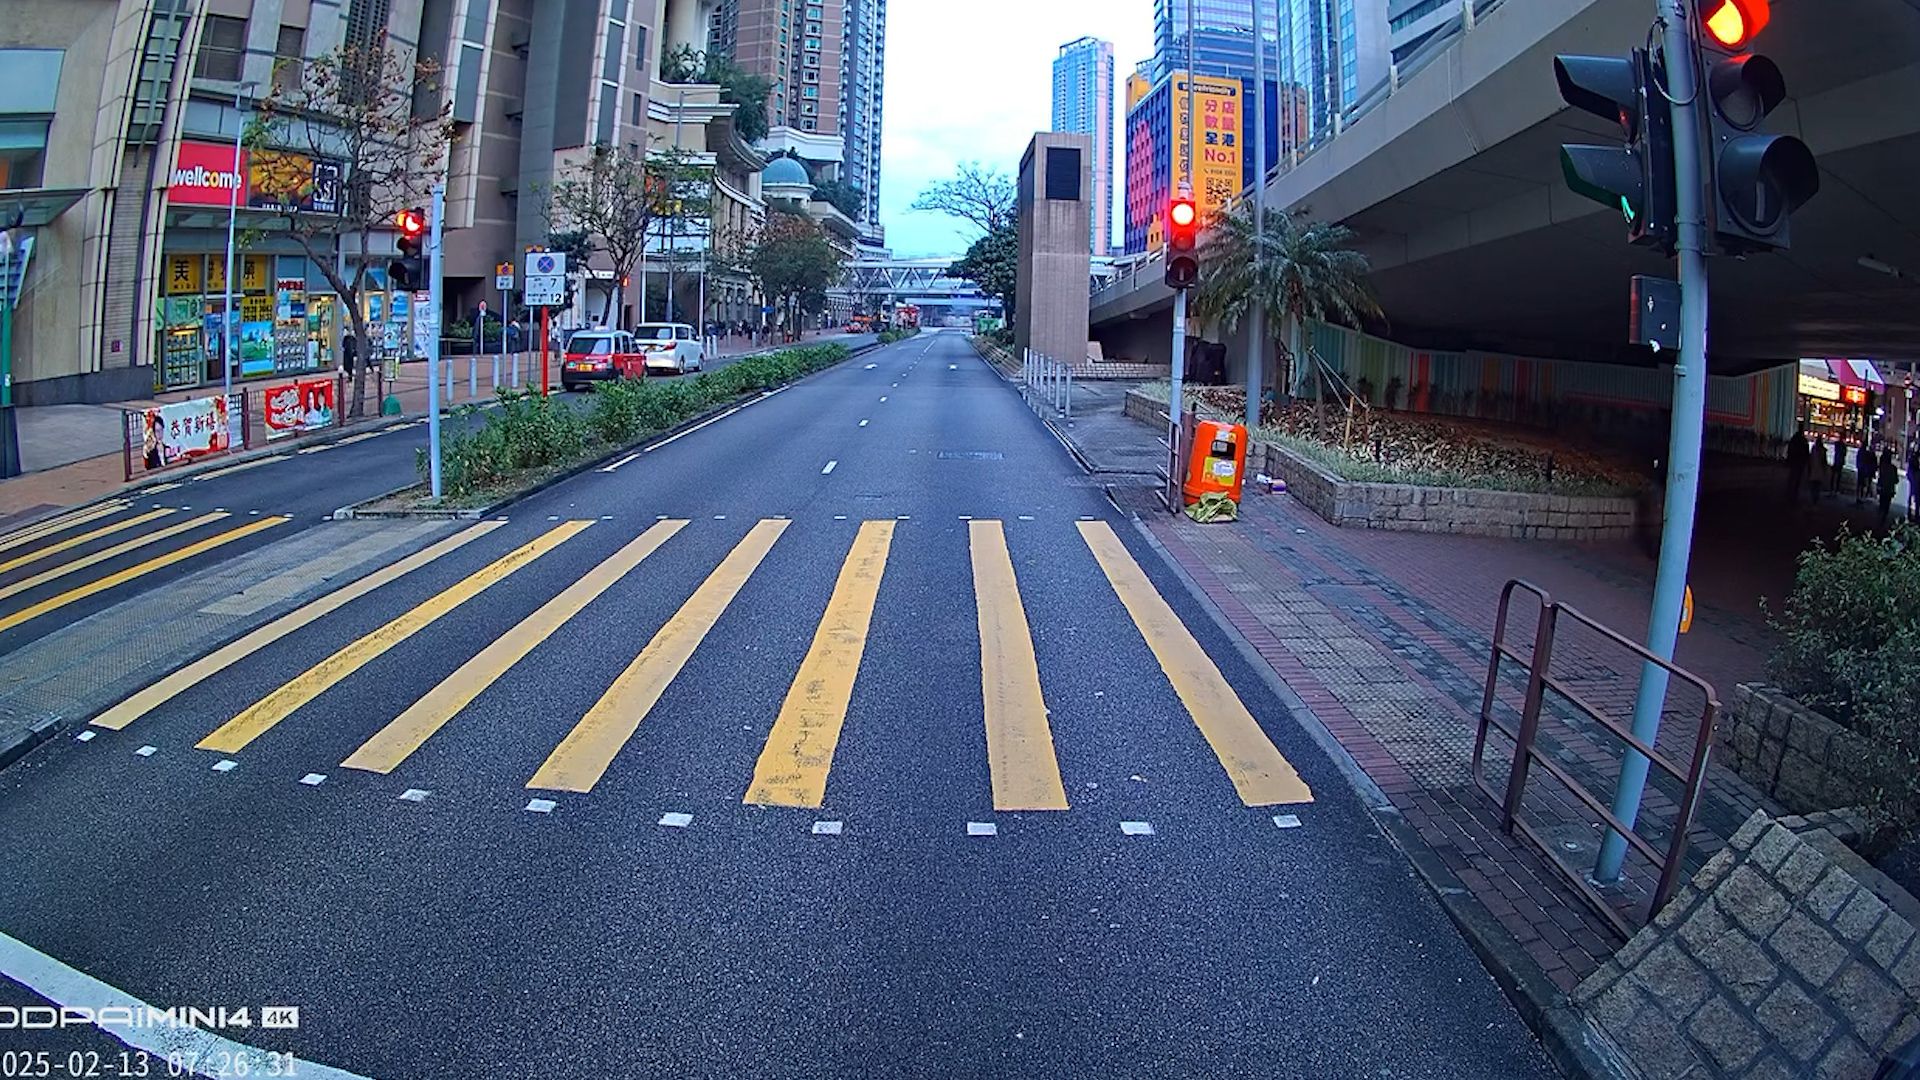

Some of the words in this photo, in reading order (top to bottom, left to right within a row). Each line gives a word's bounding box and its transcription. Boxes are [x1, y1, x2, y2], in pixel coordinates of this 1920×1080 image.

[1204, 131, 1236, 147] 全港
[1204, 148, 1236, 164] No.1
[173, 165, 243, 190] wellcome
[550, 278, 558, 288] 7
[550, 293, 562, 304] 12
[169, 410, 217, 440] 恭賀新禧
